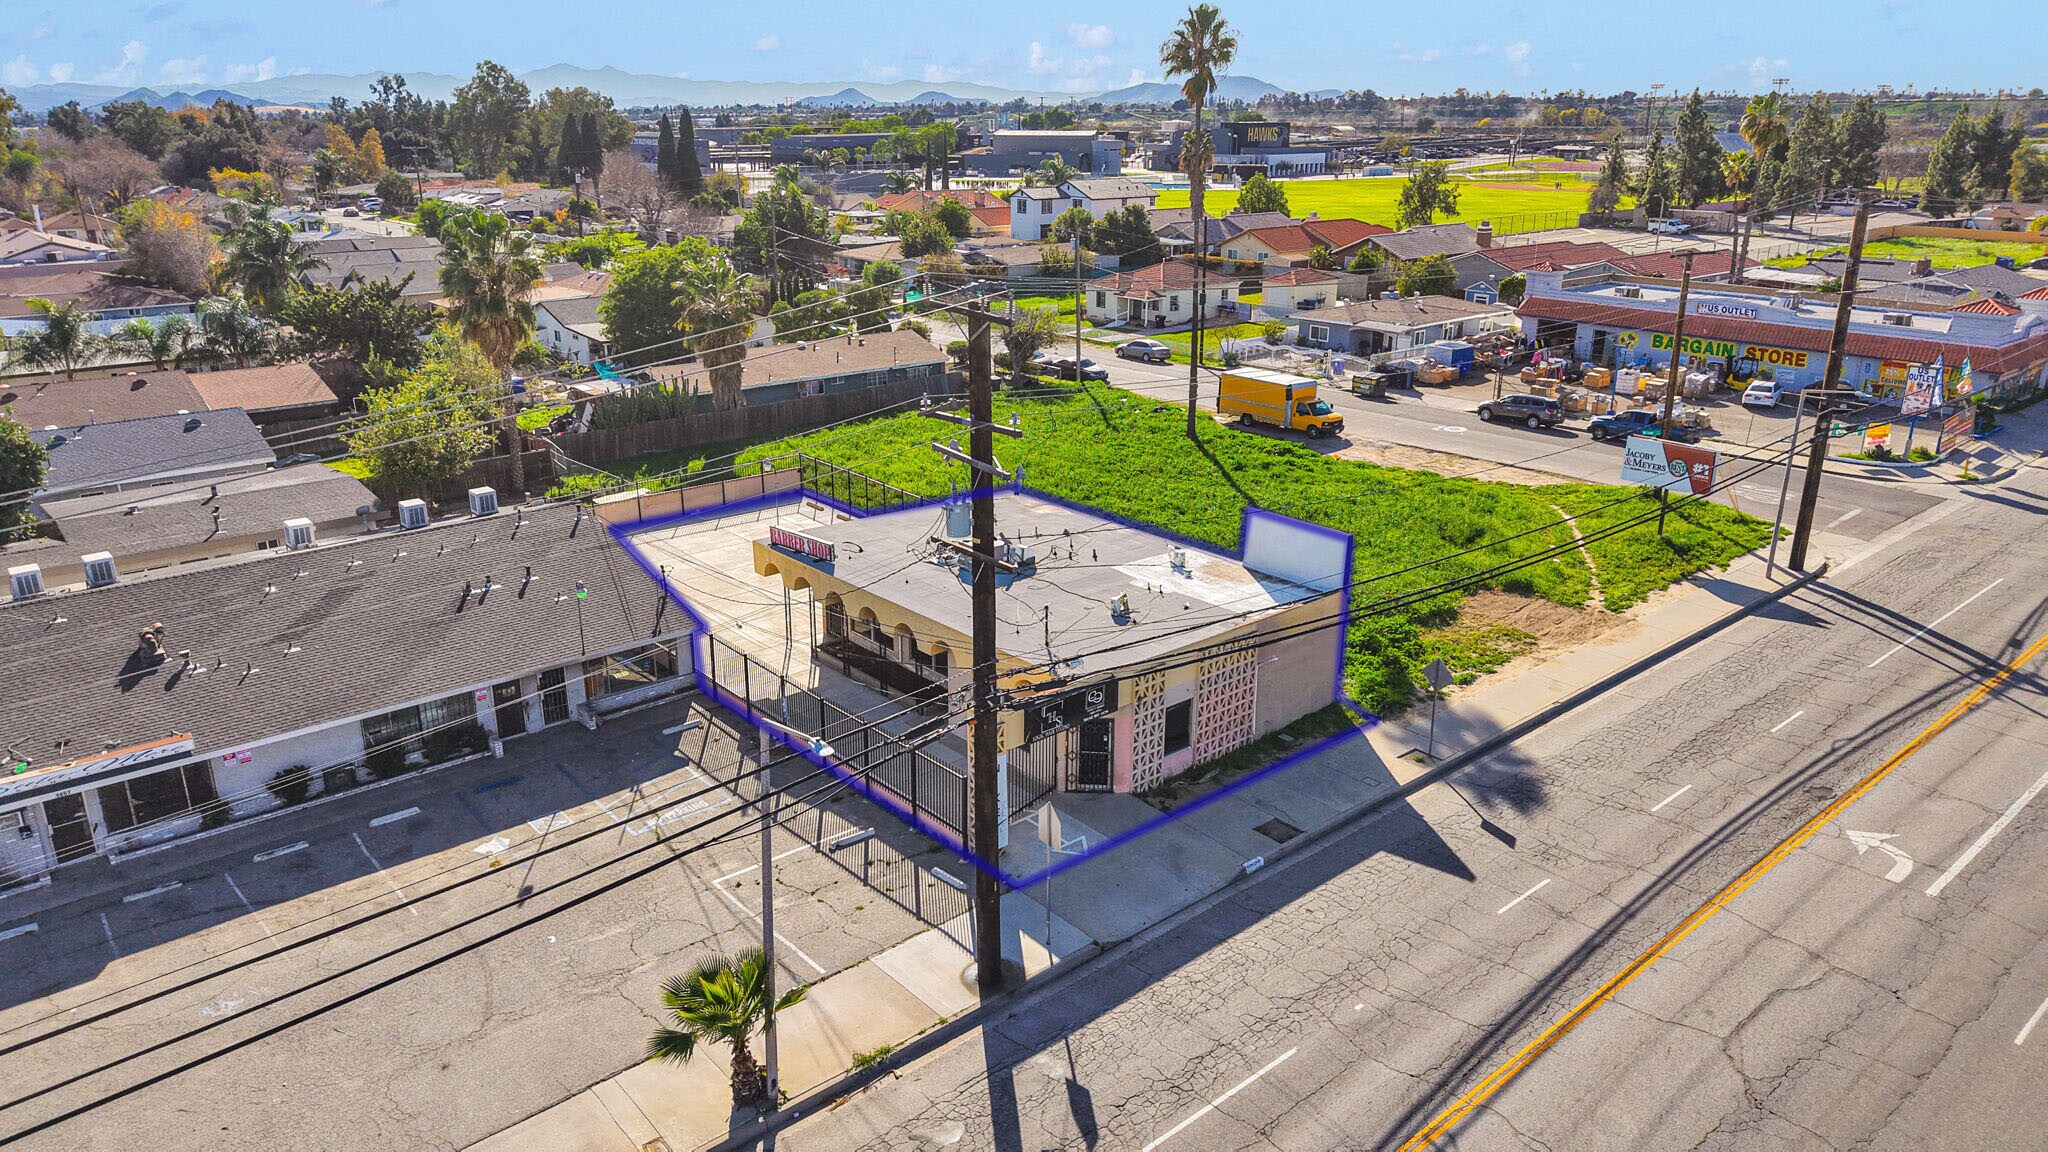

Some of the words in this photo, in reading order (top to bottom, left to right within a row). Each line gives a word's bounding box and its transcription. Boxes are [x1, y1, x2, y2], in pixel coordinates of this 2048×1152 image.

[1247, 126, 1278, 142] HAWKS
[1721, 306, 1756, 317] OUTLET
[1652, 333, 1734, 357] BARGAIN
[1745, 346, 1807, 368] STORE
[1917, 366, 1930, 375] US
[1908, 373, 1935, 383] OUTLET
[771, 528, 804, 551] BARBER
[807, 540, 830, 559] SHOP
[55, 790, 71, 798] 1657
[665, 800, 709, 819] PARKING
